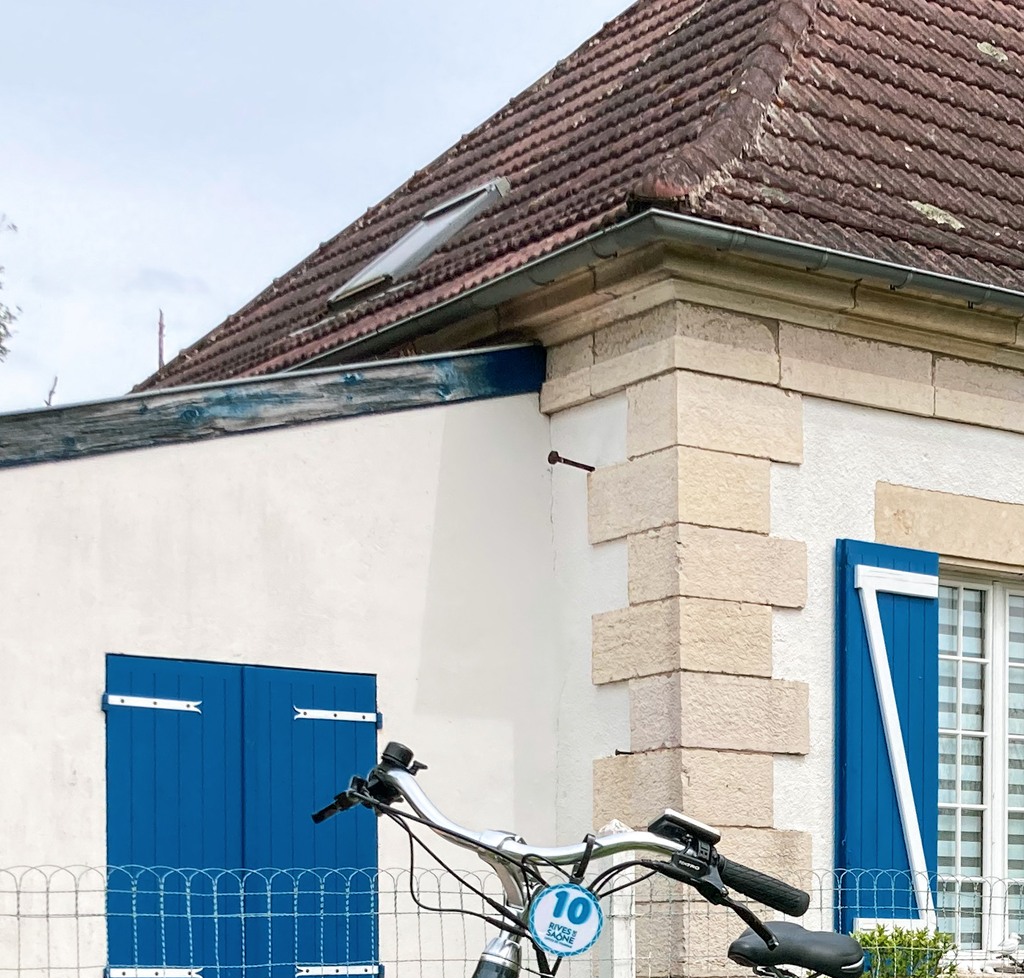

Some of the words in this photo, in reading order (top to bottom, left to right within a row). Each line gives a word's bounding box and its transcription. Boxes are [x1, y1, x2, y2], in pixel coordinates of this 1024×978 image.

[553, 890, 592, 925] 10
[548, 921, 572, 935] RIVES
[546, 929, 575, 945] SAÔNE
